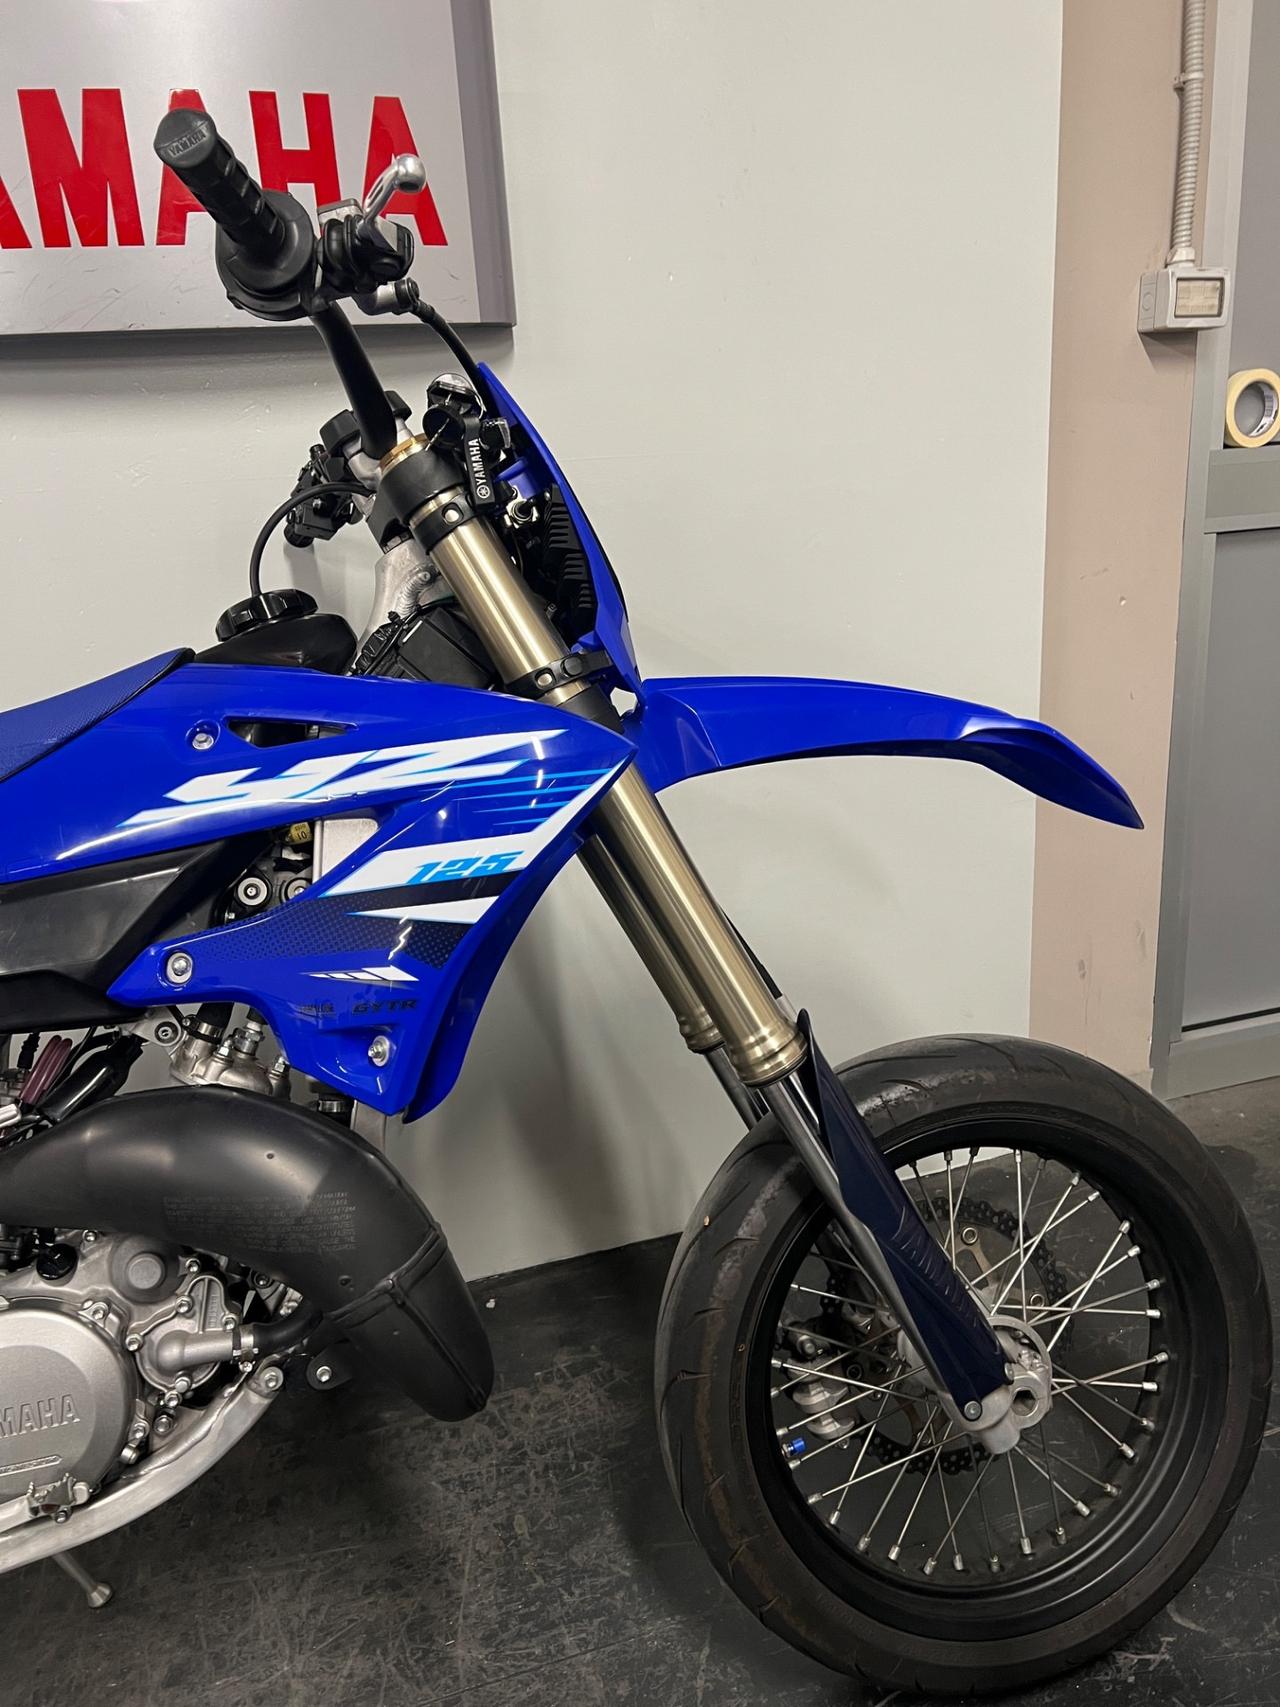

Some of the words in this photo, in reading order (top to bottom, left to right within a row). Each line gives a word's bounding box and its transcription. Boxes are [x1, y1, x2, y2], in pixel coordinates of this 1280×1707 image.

[166, 124, 209, 158] YAMAHA
[0, 88, 448, 249] MHA
[468, 438, 487, 486] YAMAHA
[115, 729, 568, 828] YZ
[405, 850, 525, 885] 125
